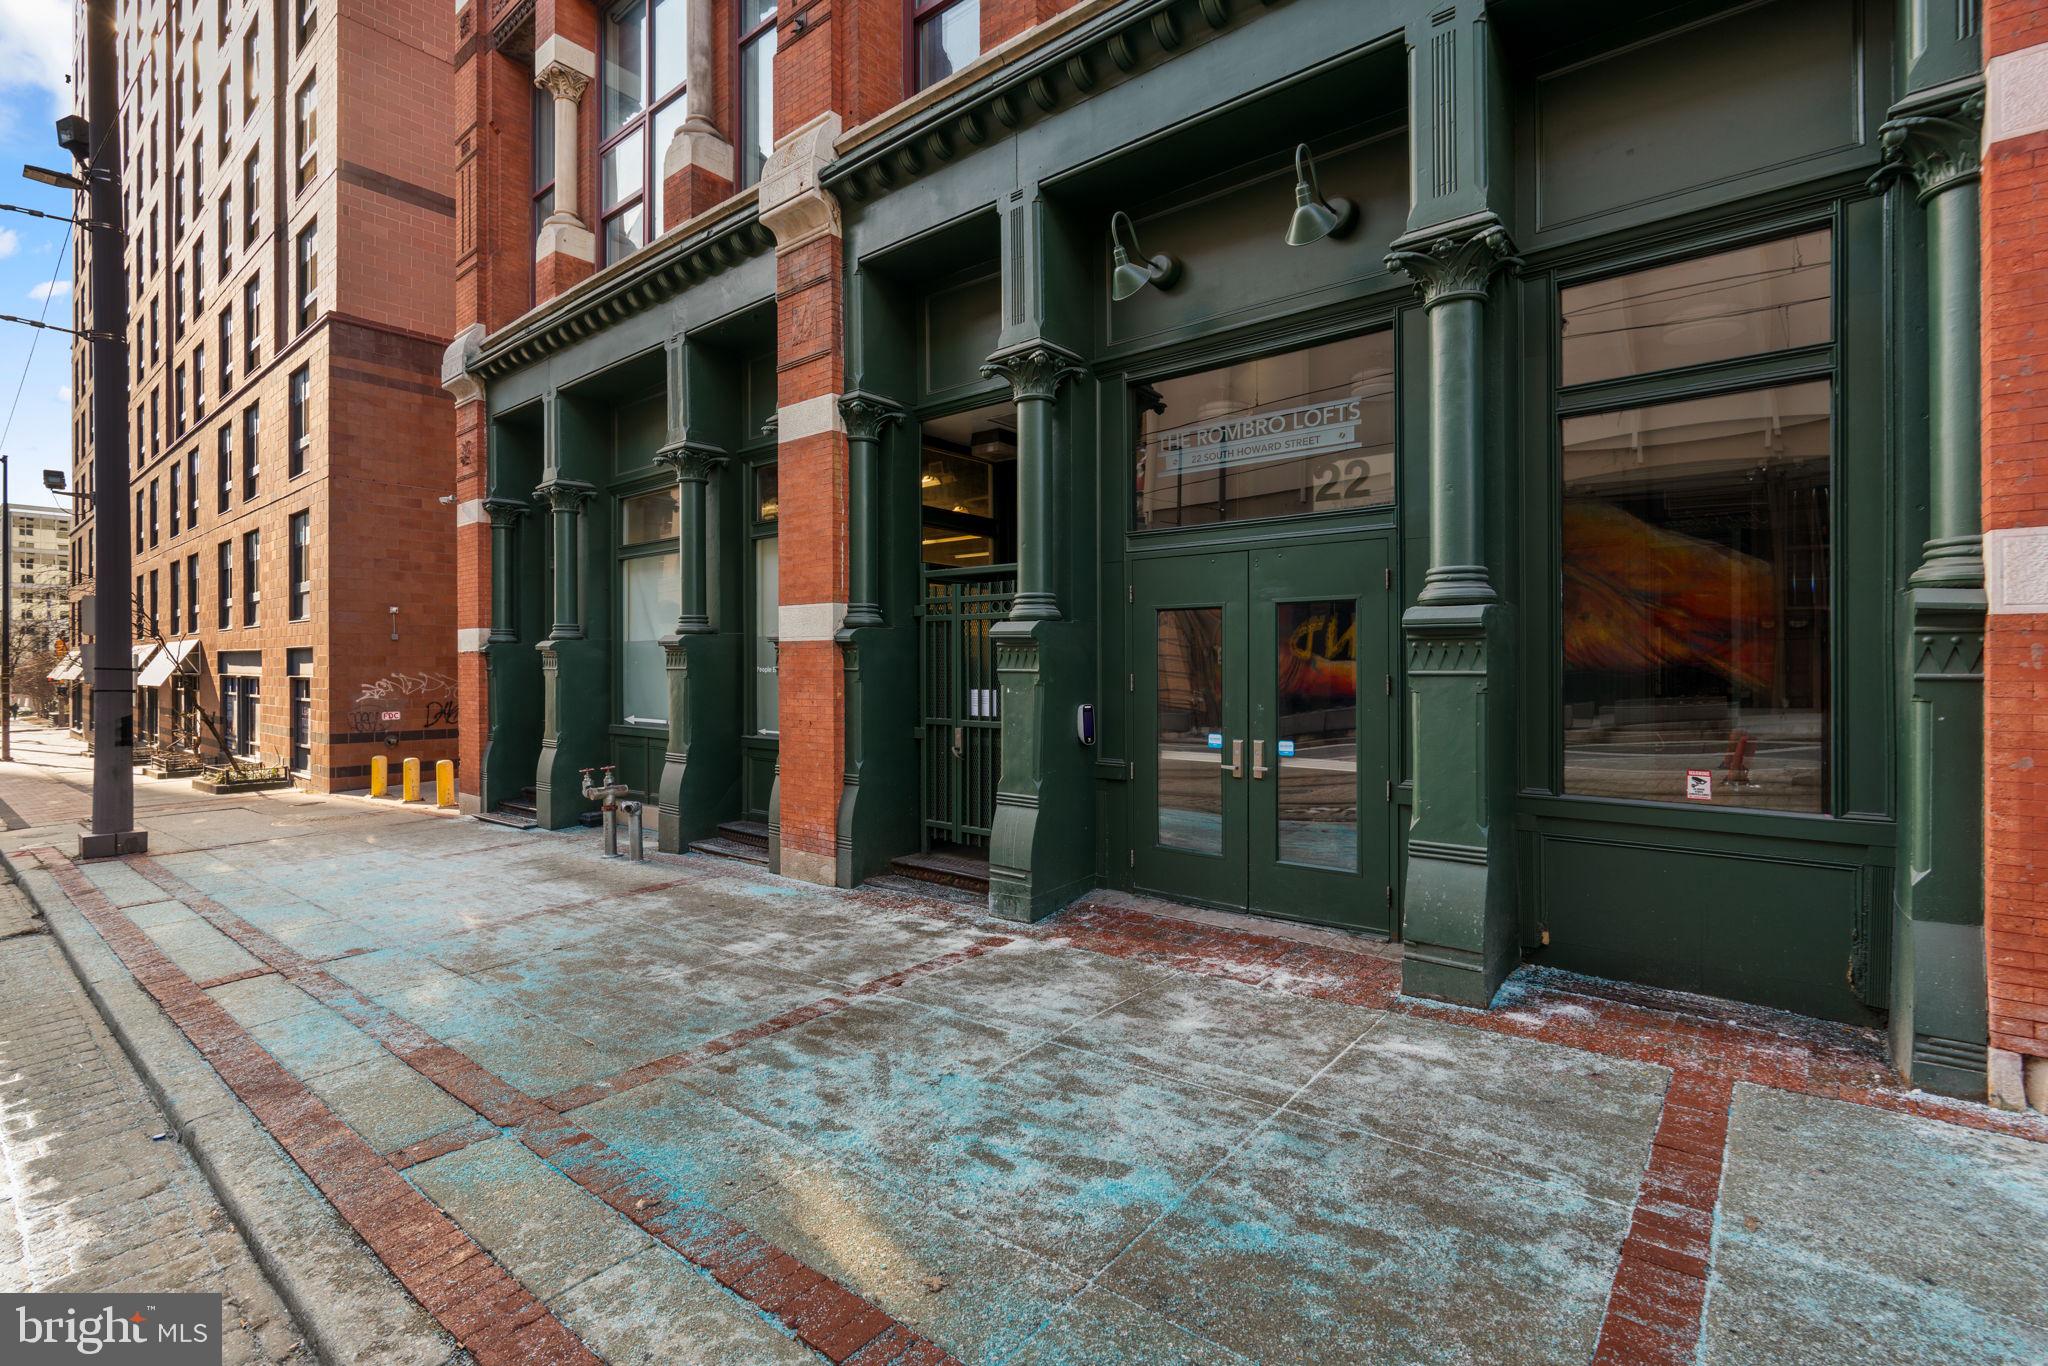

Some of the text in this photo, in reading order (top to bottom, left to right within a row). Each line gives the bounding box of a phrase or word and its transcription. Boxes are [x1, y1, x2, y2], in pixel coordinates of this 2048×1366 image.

[1160, 401, 1361, 452] THE ROMBRO LOFTS
[1191, 435, 1321, 464] 22 SOUTH HOWARD STREET
[1313, 459, 1372, 503] 22
